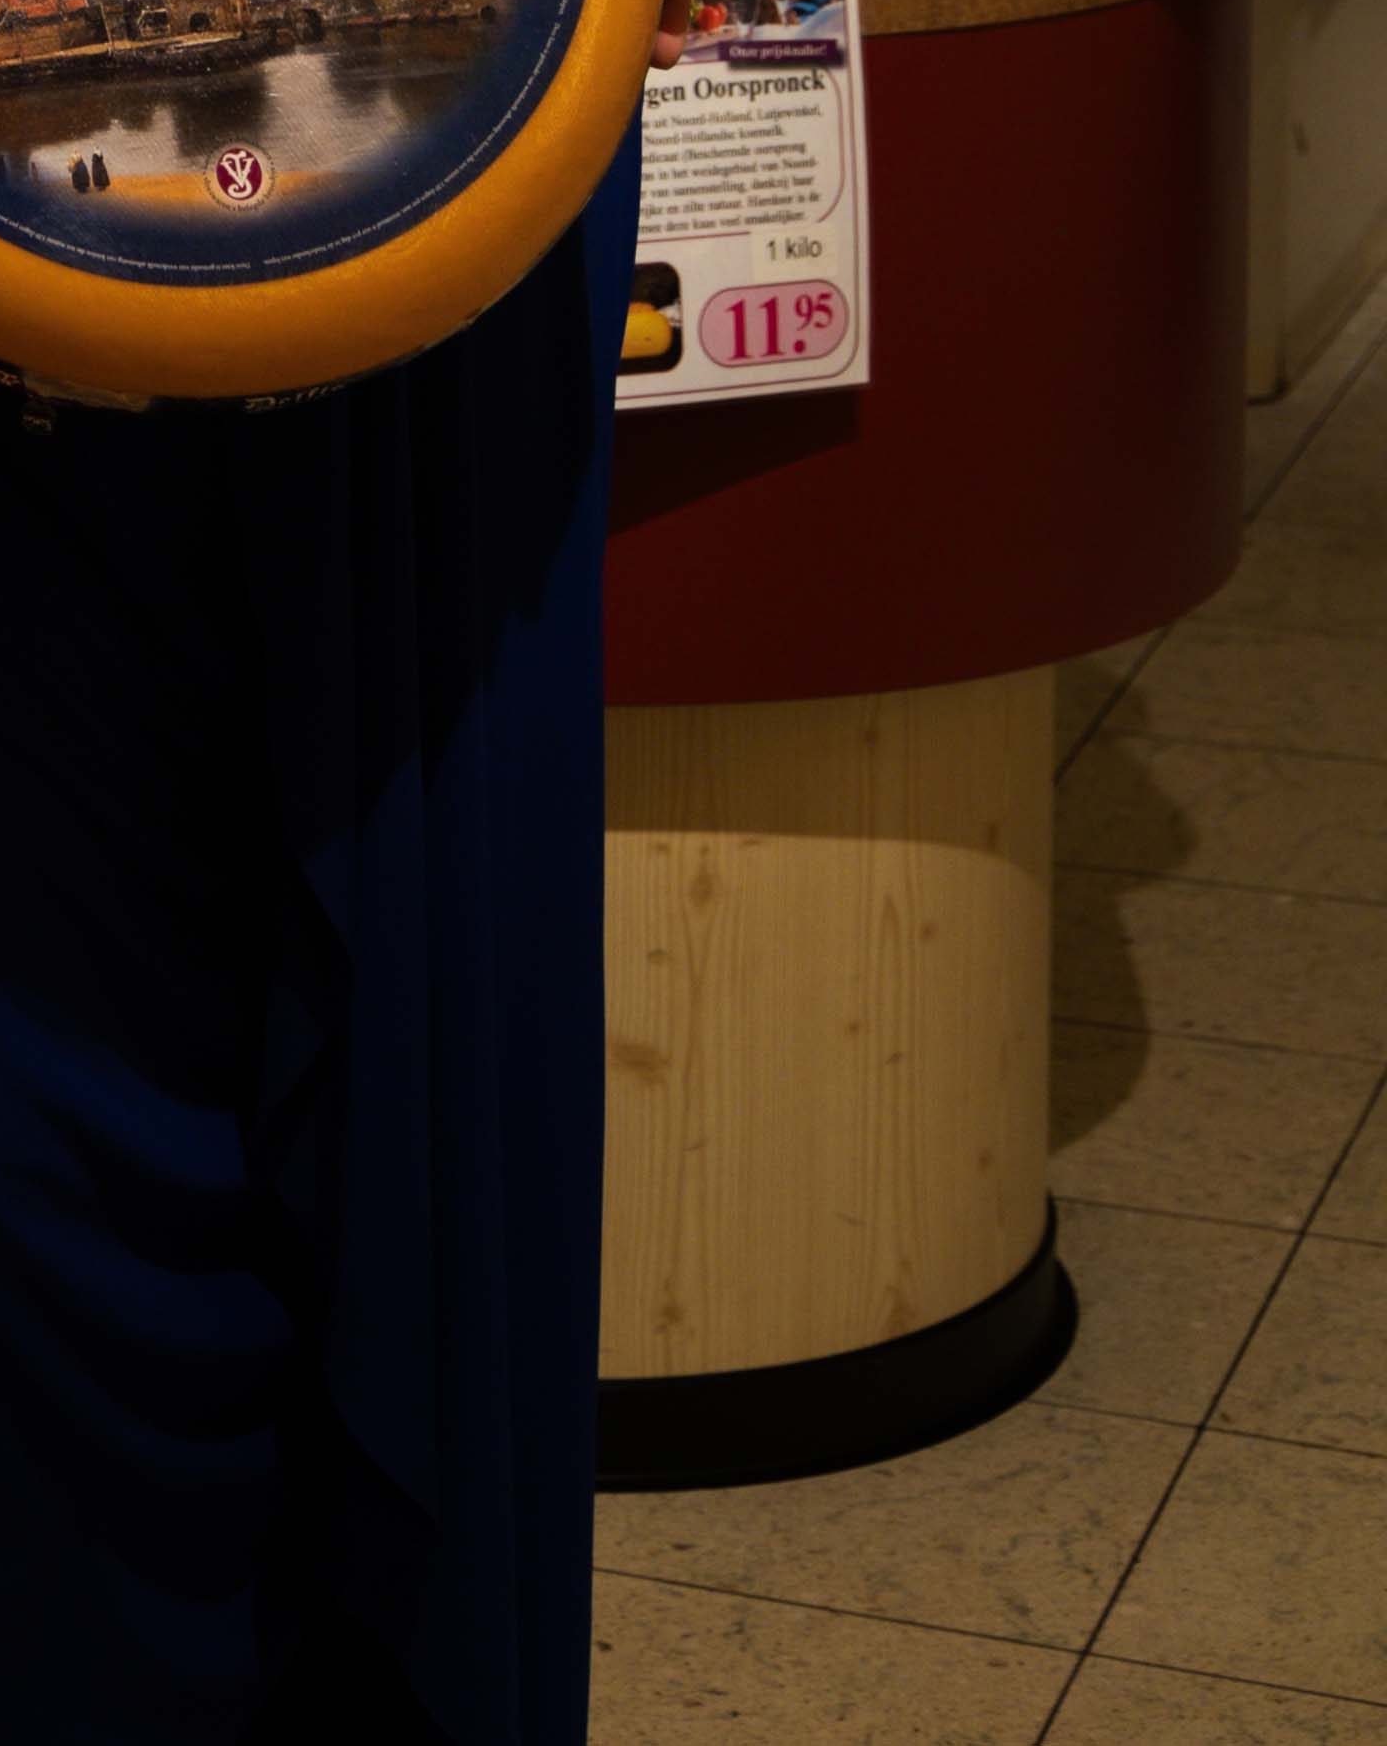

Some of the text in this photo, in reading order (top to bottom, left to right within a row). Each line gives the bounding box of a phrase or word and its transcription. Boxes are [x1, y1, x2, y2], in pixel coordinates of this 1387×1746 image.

[694, 68, 826, 103] Oorspronck
[767, 237, 823, 261] 1 kilo
[725, 290, 835, 363] 11.95
